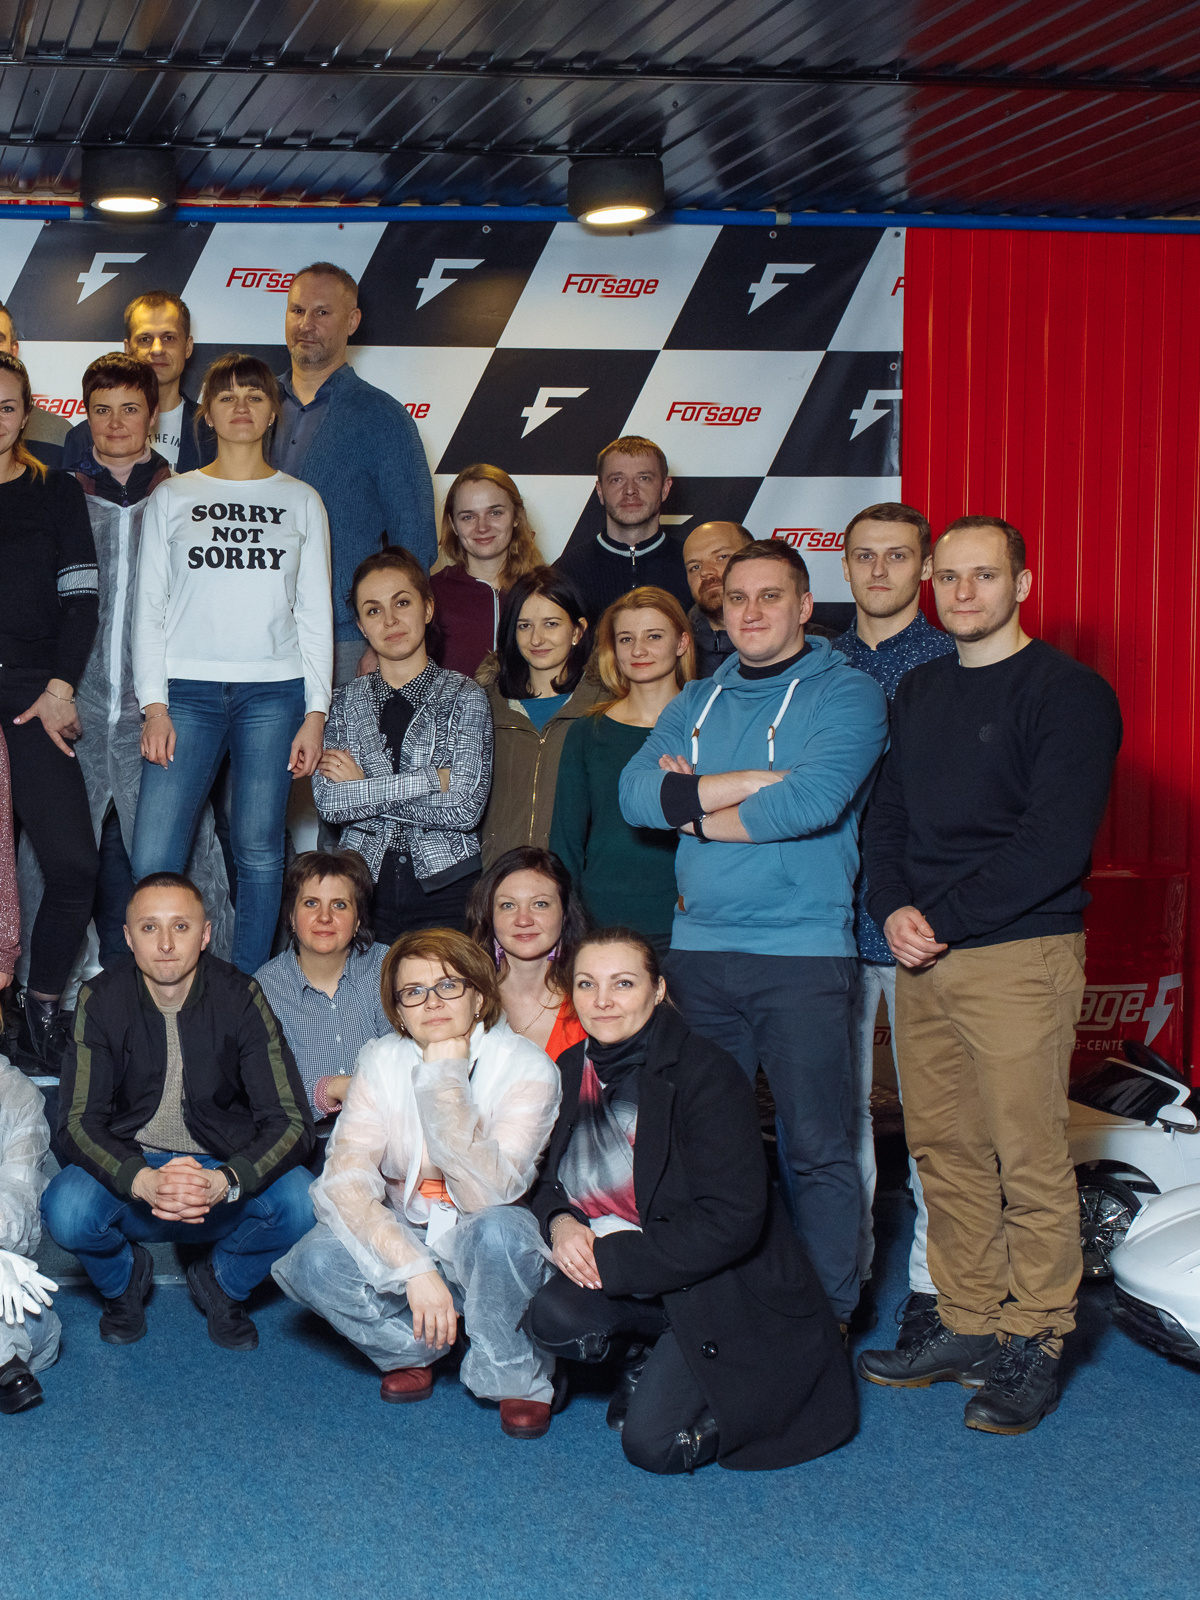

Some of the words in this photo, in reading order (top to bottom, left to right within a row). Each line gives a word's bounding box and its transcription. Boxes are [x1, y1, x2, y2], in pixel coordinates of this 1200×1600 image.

[225, 267, 296, 293] Forsa
[561, 273, 660, 299] Forsage
[665, 401, 762, 427] Forsage
[191, 502, 287, 525] SORRY
[211, 526, 264, 543] NOT
[187, 545, 287, 571] SORRY
